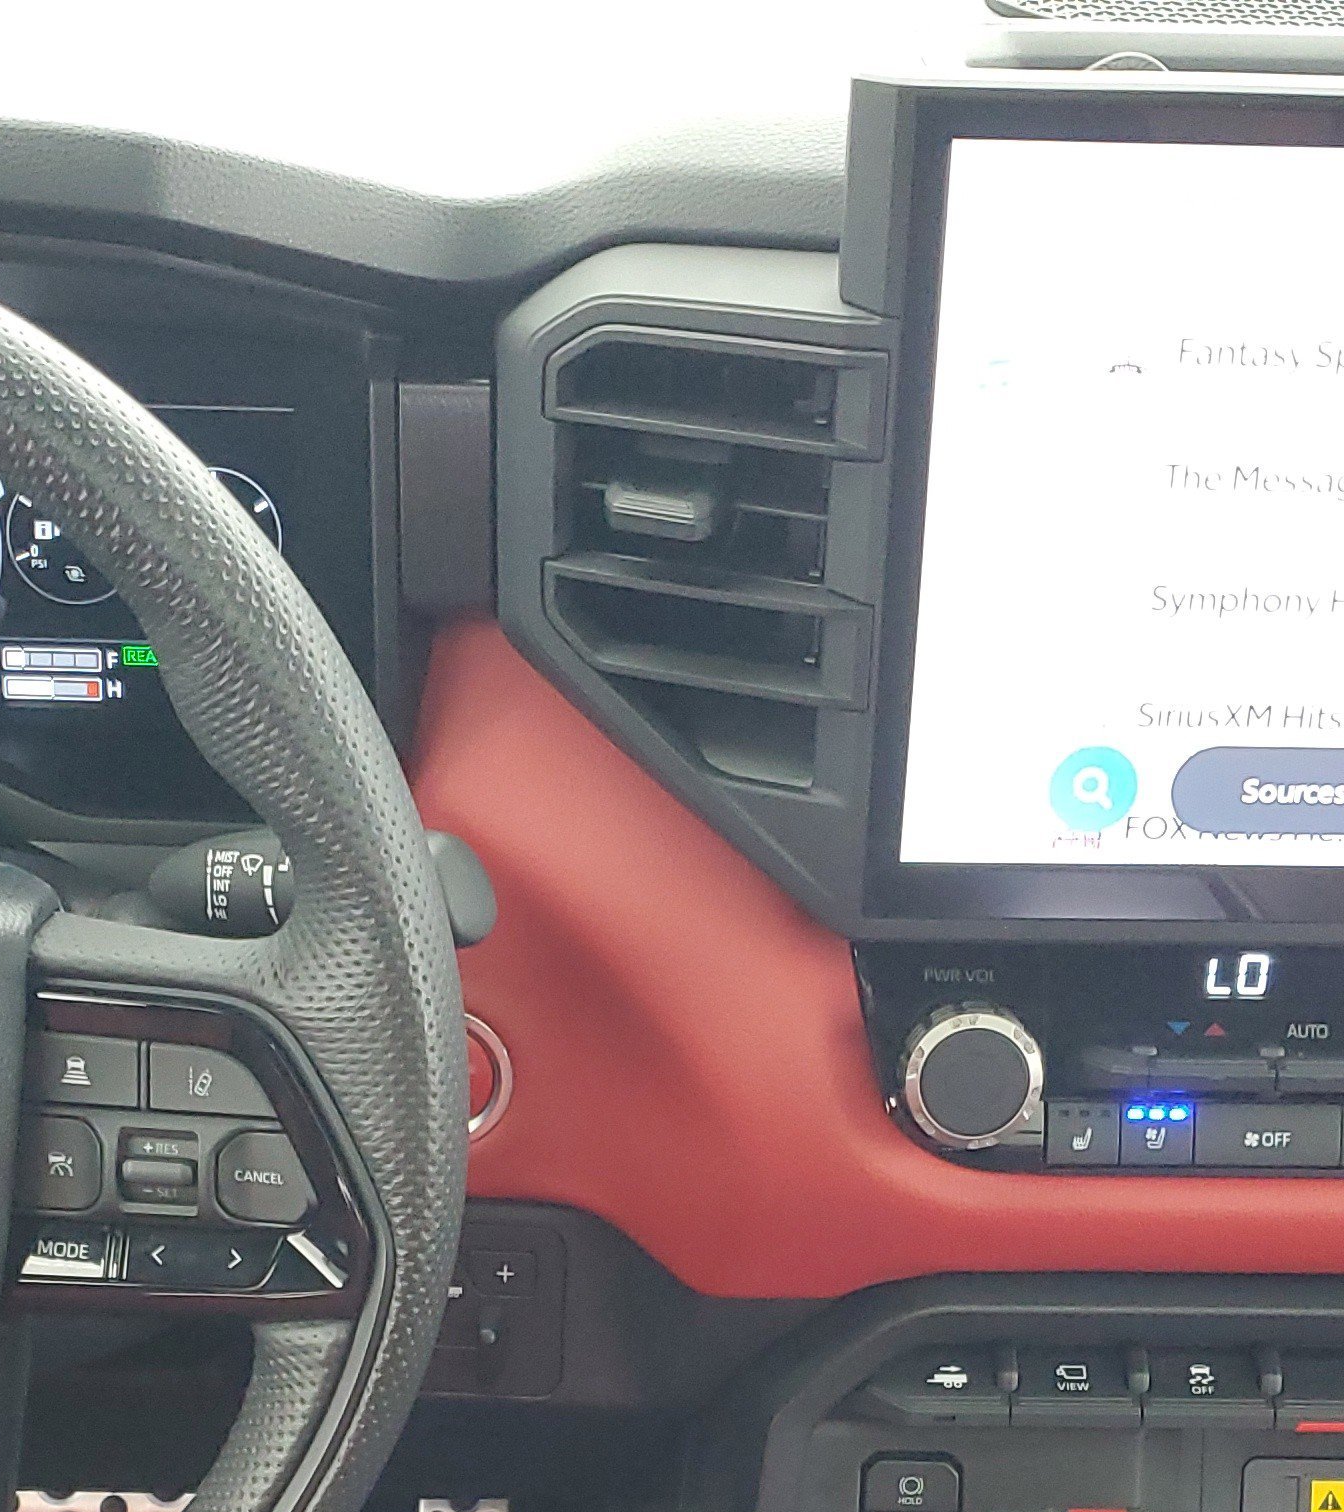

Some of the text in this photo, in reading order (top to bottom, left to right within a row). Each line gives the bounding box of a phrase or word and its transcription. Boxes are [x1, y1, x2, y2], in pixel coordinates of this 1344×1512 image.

[1179, 338, 1300, 376] Fantasy
[1165, 463, 1221, 492] The
[30, 544, 39, 557] 0
[1151, 584, 1321, 618] Symphony
[107, 648, 119, 669] F
[107, 680, 123, 699] H
[1138, 702, 1273, 729] SiriusXM
[1282, 704, 1342, 730] Hits
[1125, 816, 1187, 840] FOX
[214, 850, 241, 864] MIST
[213, 864, 235, 878] OFF
[213, 879, 231, 892] INT
[212, 894, 228, 907] LO
[1205, 952, 1271, 998] LO
[1287, 1021, 1329, 1040] AUTO
[1261, 1130, 1292, 1148] OFF
[234, 1168, 284, 1186] CANCEL
[37, 1240, 89, 1260] MODE
[1056, 1380, 1090, 1392] VIEW
[1191, 1384, 1215, 1395] OFF
[897, 1496, 923, 1506] HOLD
